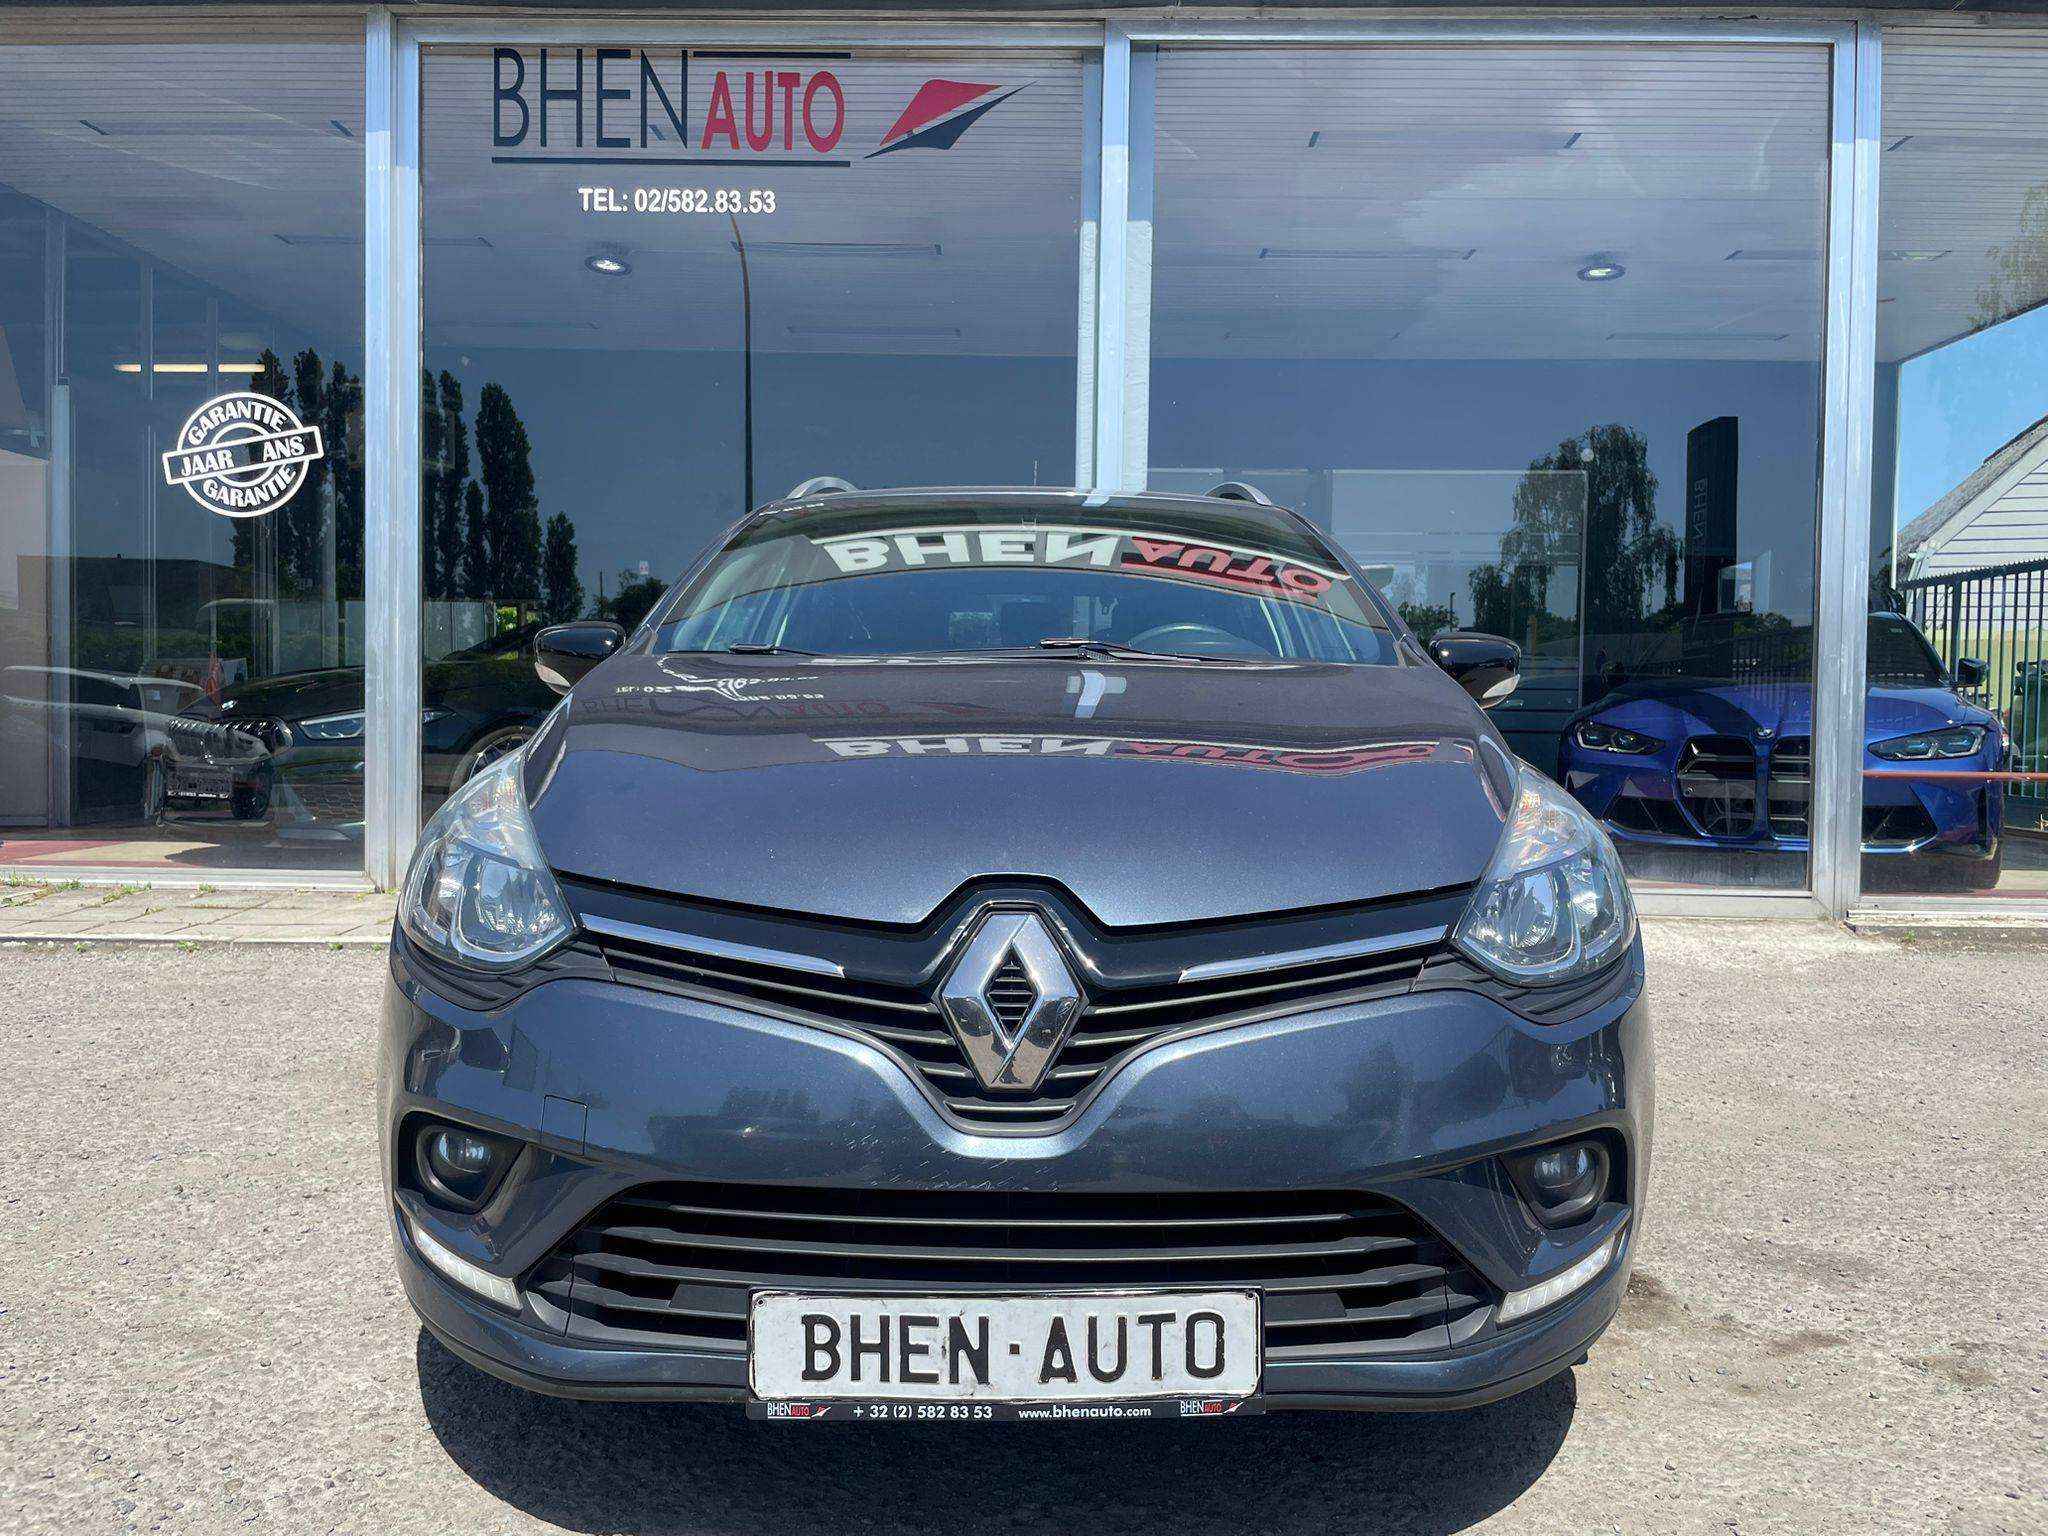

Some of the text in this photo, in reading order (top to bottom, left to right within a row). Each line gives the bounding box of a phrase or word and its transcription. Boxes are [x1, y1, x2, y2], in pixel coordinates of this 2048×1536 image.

[493, 48, 846, 154] BHEN AUTO
[578, 187, 777, 214] TEL: 02/582.83.53
[188, 401, 287, 446] GARANTIE
[181, 435, 306, 477] JAAR ANS
[202, 463, 297, 508] GARANTIE
[801, 1314, 990, 1384] BHEN
[1038, 1312, 1225, 1383] AUTO
[767, 1403, 810, 1416] BHEN AUTO
[869, 1406, 888, 1418] 32
[893, 1406, 913, 1418] (2)
[917, 1406, 946, 1418] 582
[950, 1406, 969, 1418] 83
[973, 1406, 993, 1418] 53
[1018, 1405, 1152, 1419] www.bhenauto.com
[1180, 1401, 1223, 1413] BHEN AUTO
